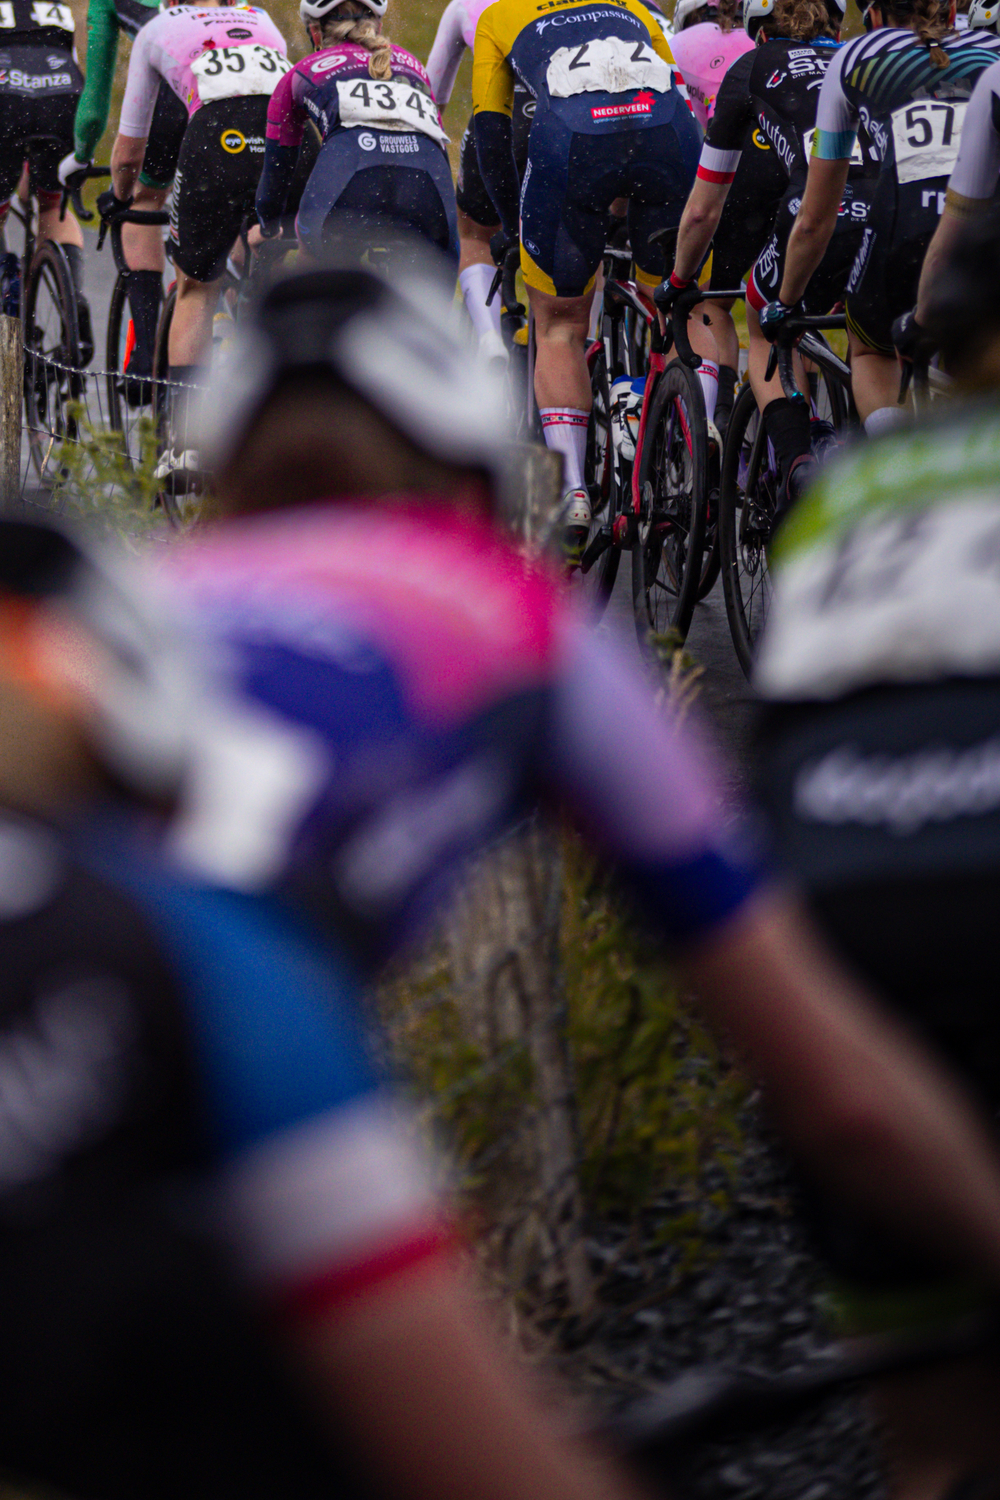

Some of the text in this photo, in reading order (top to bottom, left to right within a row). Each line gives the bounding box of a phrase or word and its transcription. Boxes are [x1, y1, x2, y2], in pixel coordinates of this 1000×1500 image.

[47, 6, 67, 24] 4
[551, 9, 642, 29] Compassion
[203, 48, 246, 77] 35
[9, 69, 72, 89] Stanza
[350, 82, 398, 111] 43
[593, 103, 650, 118] NEDERVEEN
[905, 105, 955, 148] 57
[379, 135, 418, 144] GROUWELS
[380, 143, 420, 153] VASTGOED
